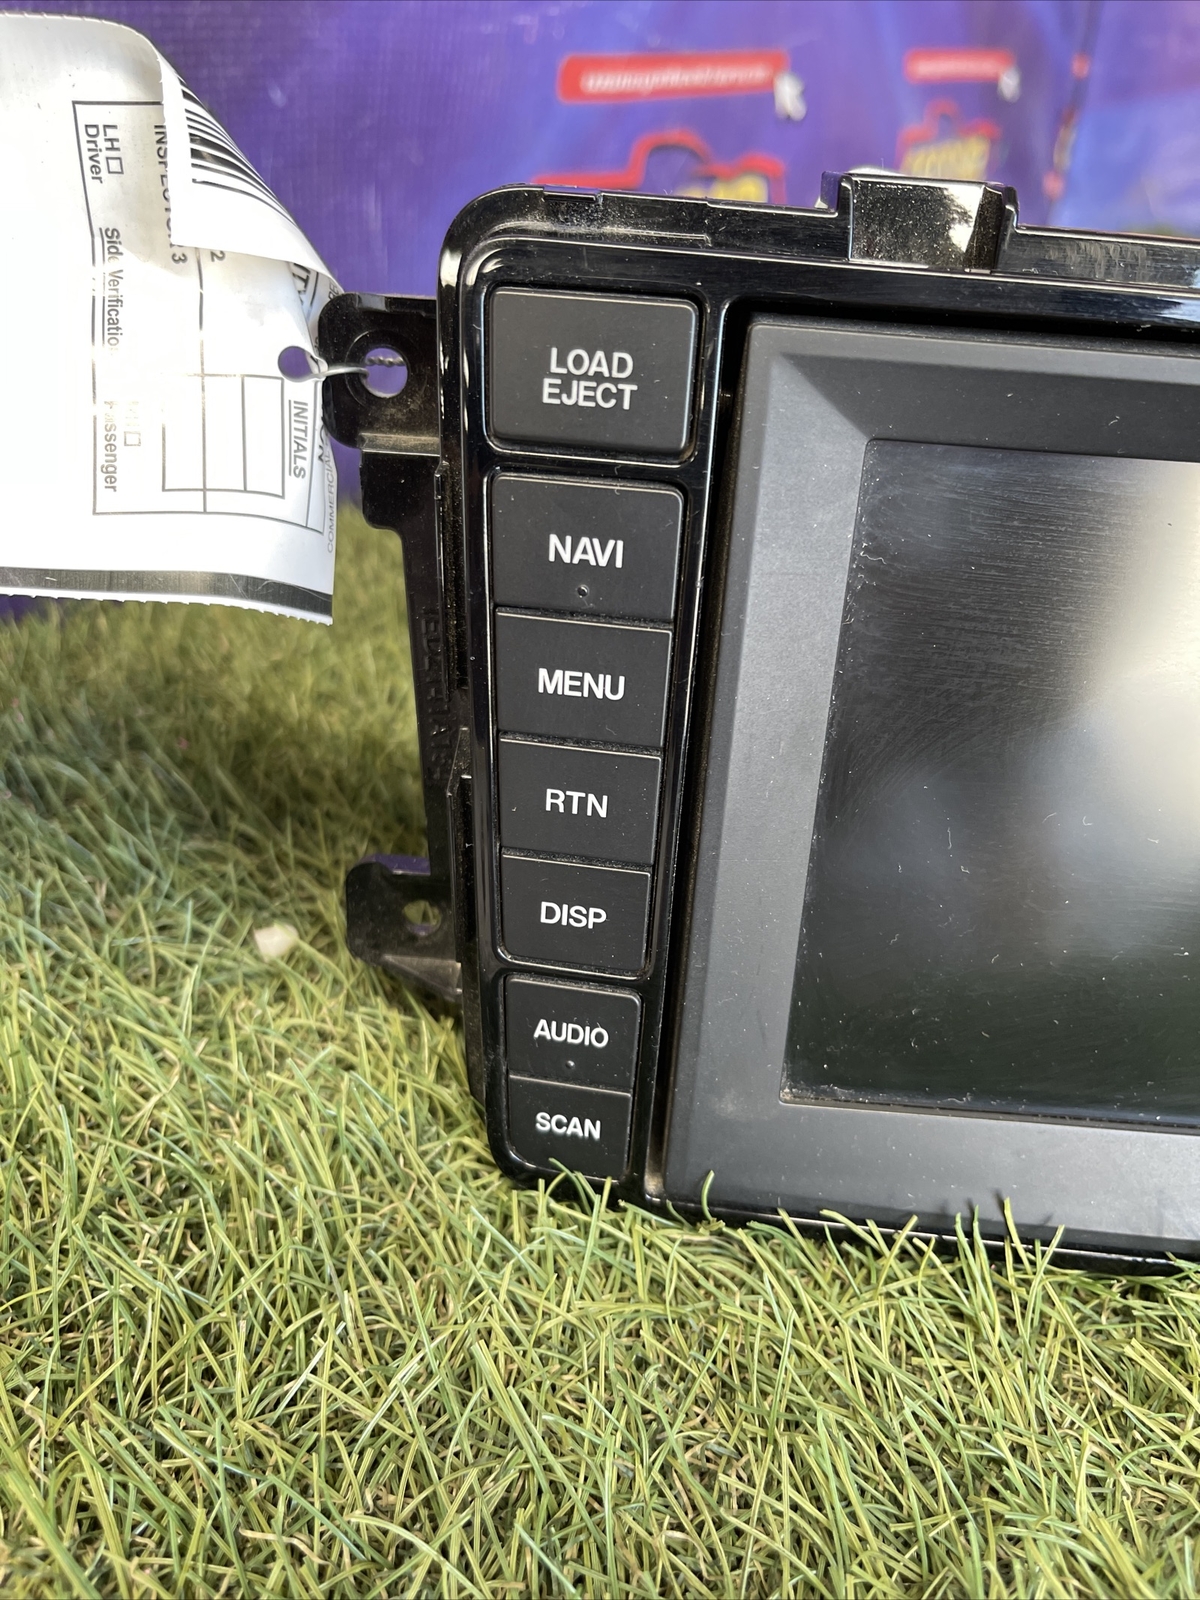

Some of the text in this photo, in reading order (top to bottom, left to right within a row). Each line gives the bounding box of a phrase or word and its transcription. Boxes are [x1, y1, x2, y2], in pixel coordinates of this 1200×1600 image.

[84, 124, 105, 184] Driver
[102, 124, 121, 152] LH
[171, 252, 188, 265] 3
[104, 227, 123, 355] Side Verificatio
[549, 346, 634, 380] LOAD
[542, 378, 638, 411] EJECT
[293, 400, 308, 479] INITIALS
[324, 455, 336, 554] COMMERCIAL
[548, 533, 625, 569] NAVI
[537, 667, 626, 701] MENU
[545, 788, 609, 819] RTN
[539, 901, 608, 930] DISP
[533, 1018, 610, 1049] AUDIO
[535, 1111, 602, 1140] SCAN
